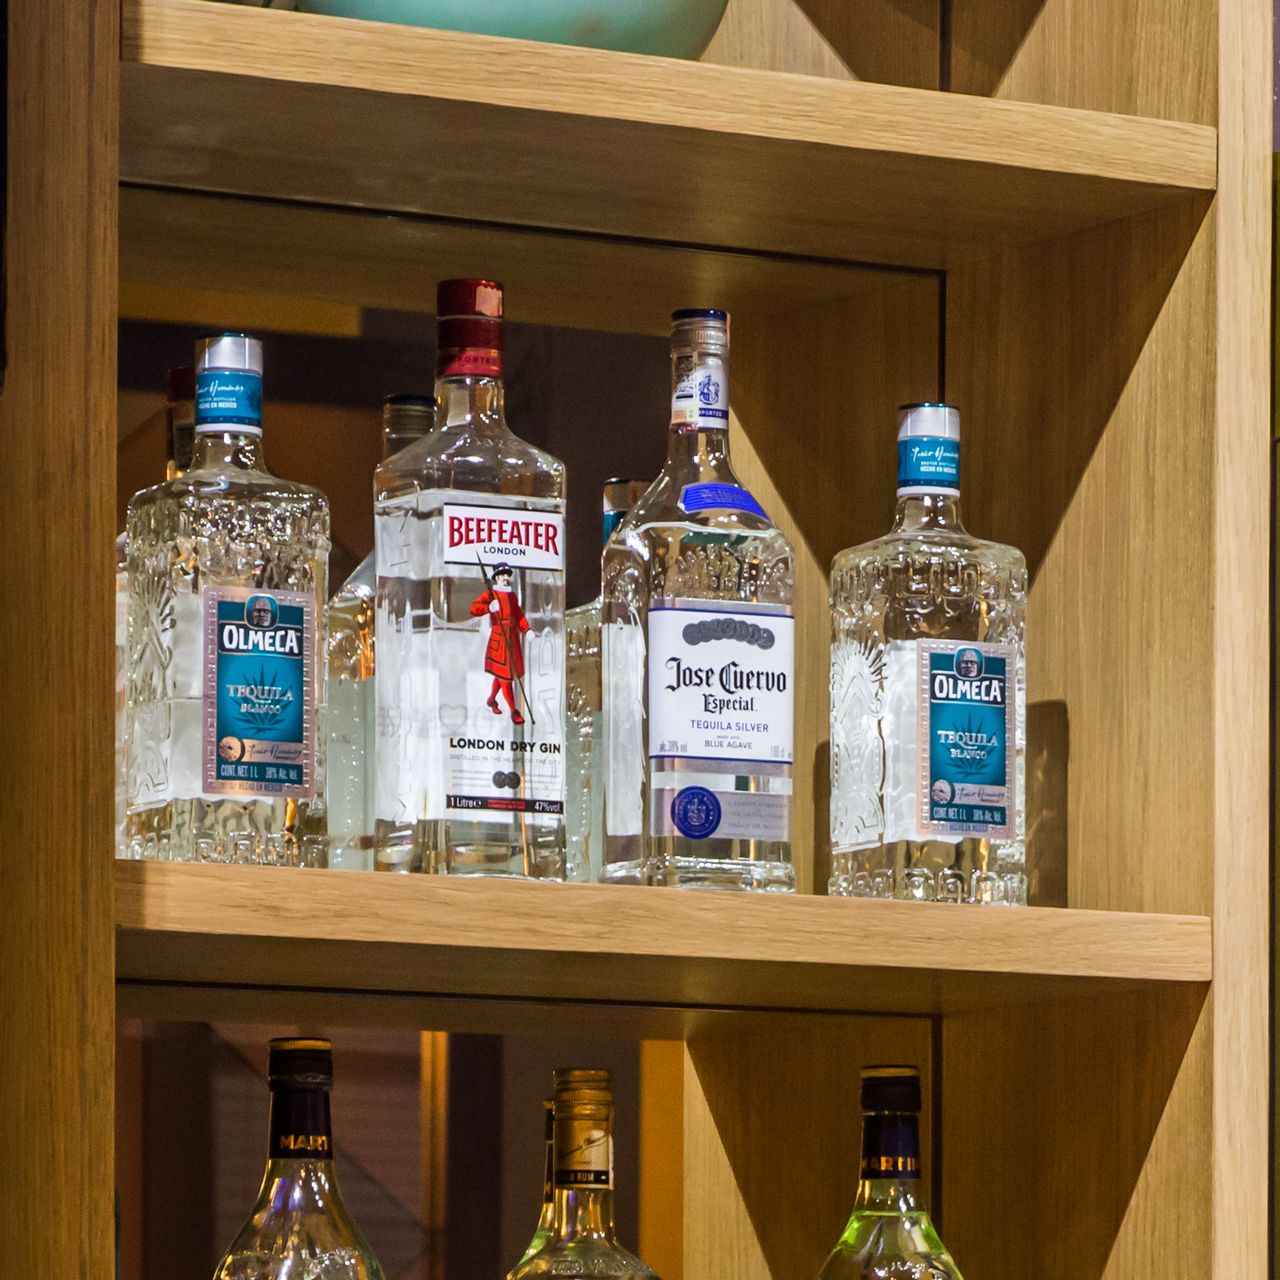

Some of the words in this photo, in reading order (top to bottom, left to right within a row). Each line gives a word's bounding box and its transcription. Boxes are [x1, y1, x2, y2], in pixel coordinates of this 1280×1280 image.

[449, 516, 559, 556] BEEFEATER
[484, 546, 526, 557] LONDON
[223, 625, 299, 654] OLMECA
[664, 657, 714, 691] Jose
[719, 661, 787, 694] Cuervo
[226, 684, 294, 703] TEQUILA
[934, 675, 1001, 702] OLMECA
[240, 703, 282, 714] BLANCO
[690, 720, 733, 731] TEQUILA
[735, 722, 769, 733] SILVER
[450, 738, 505, 751] LONDON
[511, 741, 536, 753] DRY
[540, 743, 561, 754] GIN
[704, 740, 724, 748] BLUE
[726, 741, 752, 750] AGAVE
[937, 730, 999, 749] TEQUILA
[950, 749, 987, 760] BLANCO
